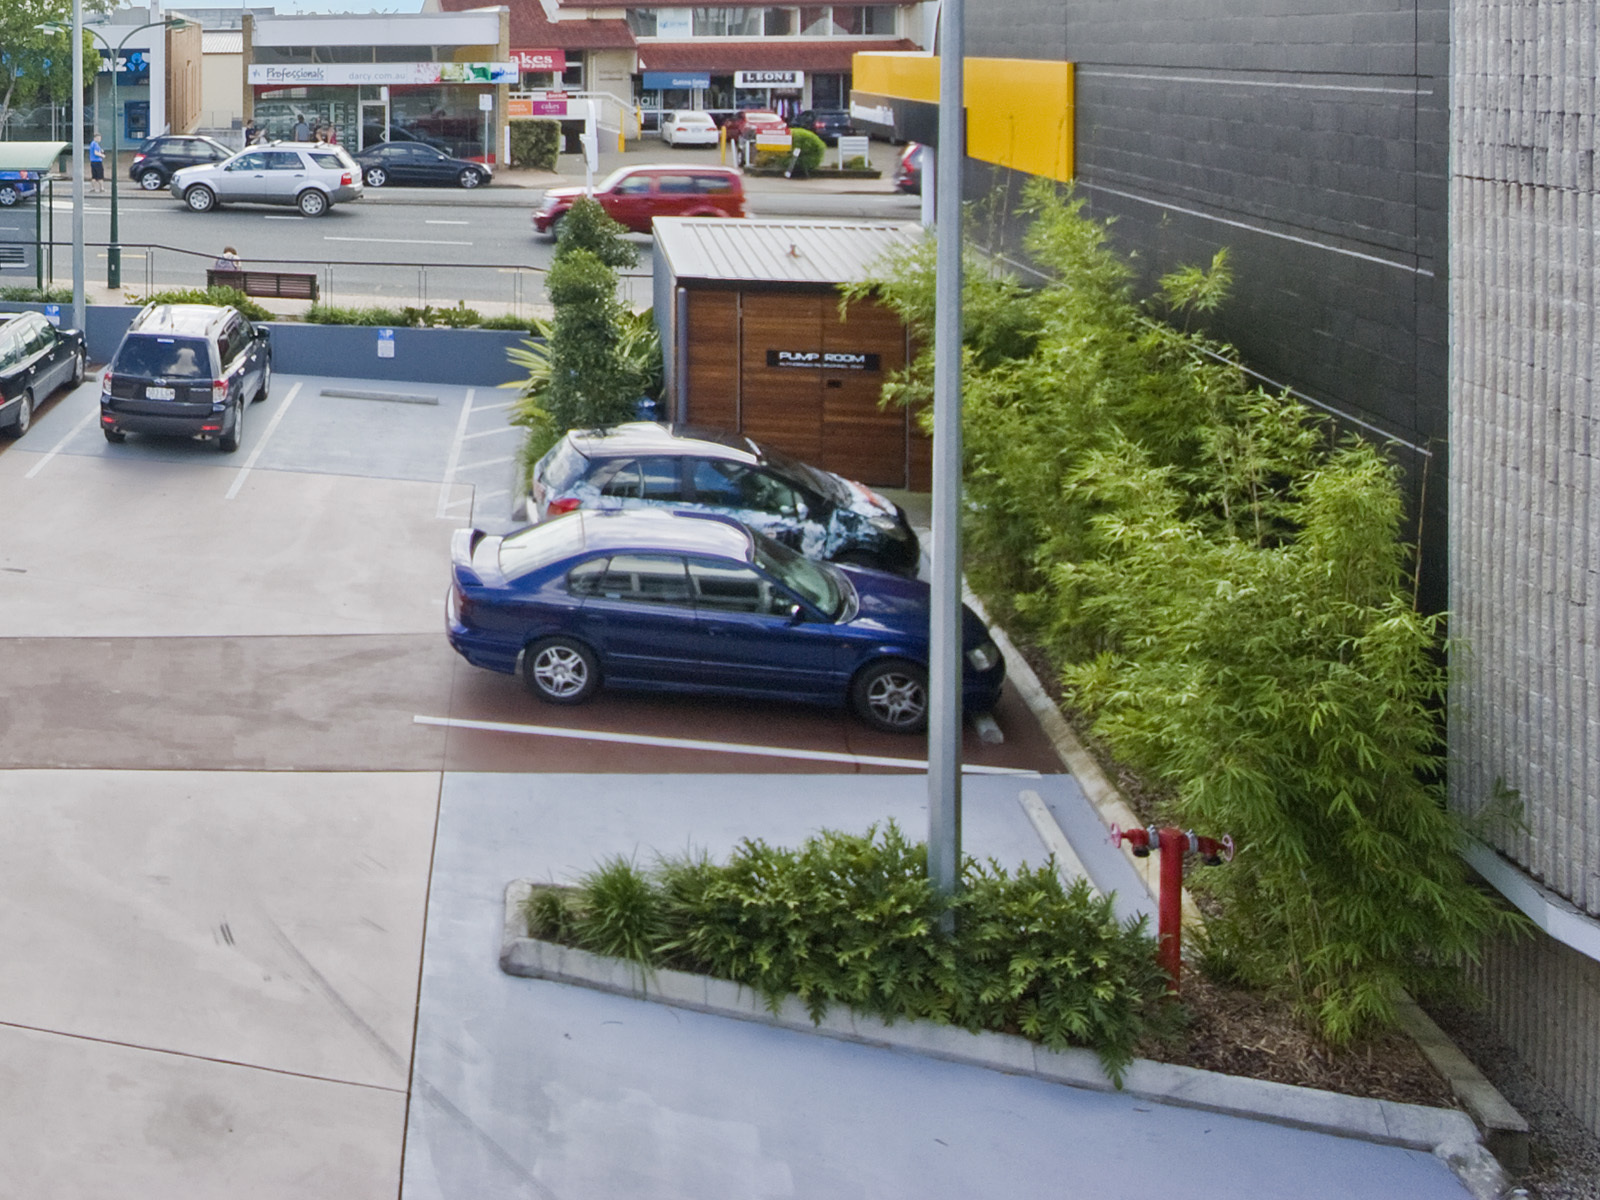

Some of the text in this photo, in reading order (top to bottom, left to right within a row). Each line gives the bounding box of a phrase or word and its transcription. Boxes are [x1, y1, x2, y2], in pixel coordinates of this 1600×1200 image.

[509, 52, 553, 64] akes
[266, 67, 325, 81] Professionals
[779, 351, 866, 363] PUMP ROOM
